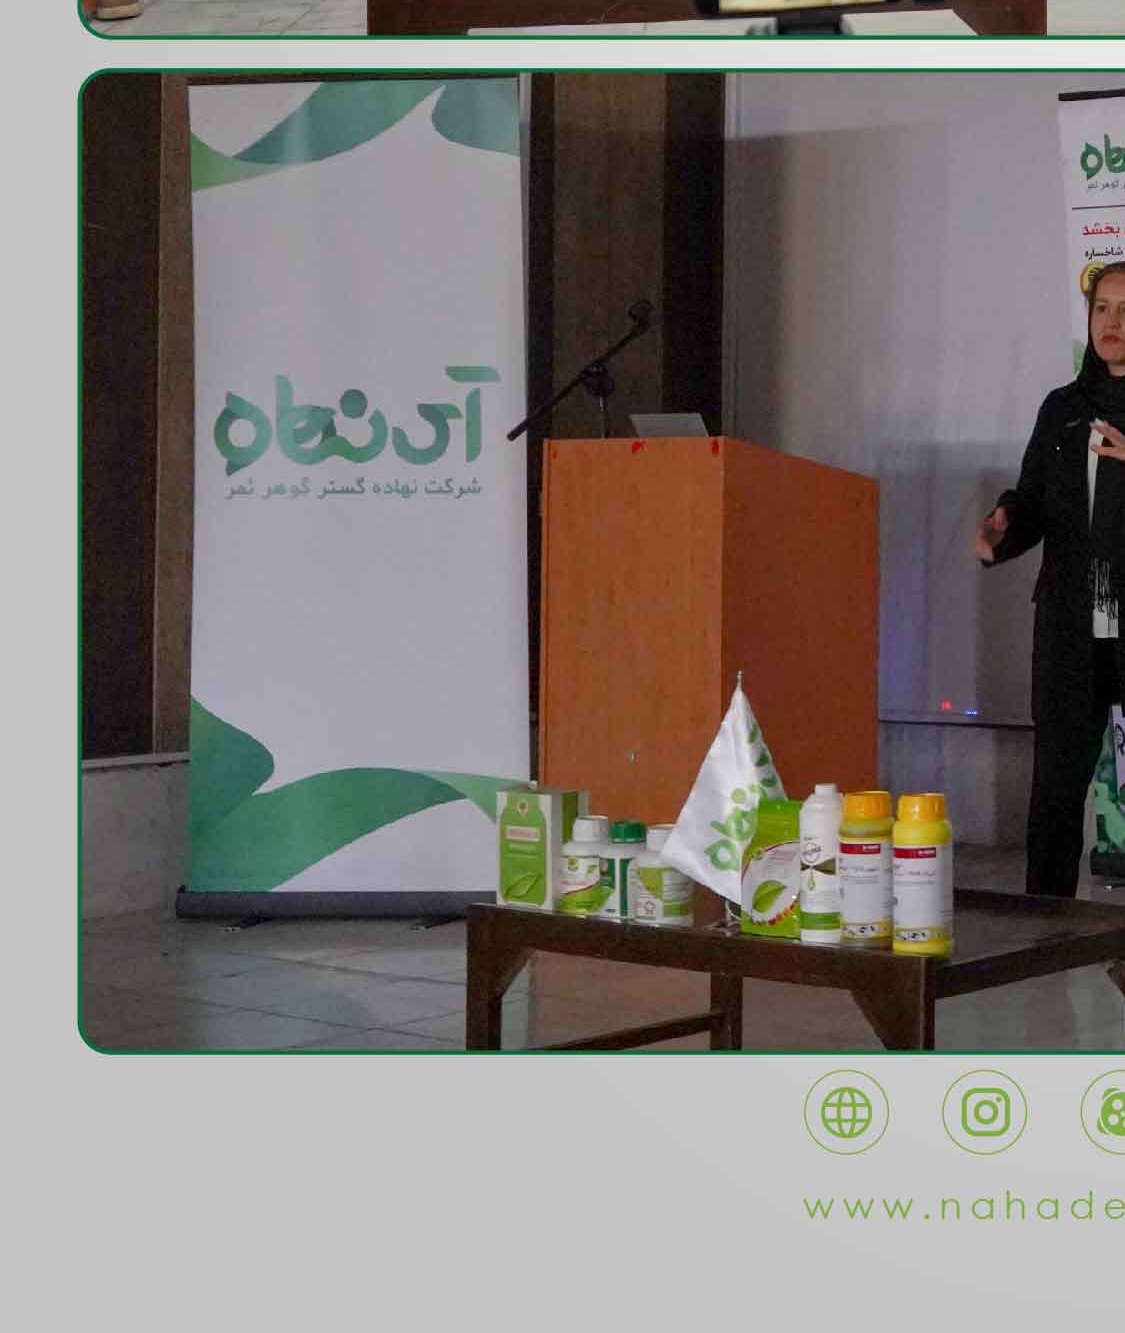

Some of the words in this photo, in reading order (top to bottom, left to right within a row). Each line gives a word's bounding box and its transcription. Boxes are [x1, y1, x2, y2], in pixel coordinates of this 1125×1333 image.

[1082, 221, 1121, 238] بخشد
[224, 478, 255, 501] ثمر
[261, 477, 311, 501] گوهر
[316, 477, 365, 501] گستر
[372, 478, 418, 500] نهاده
[425, 476, 482, 500] شرکت
